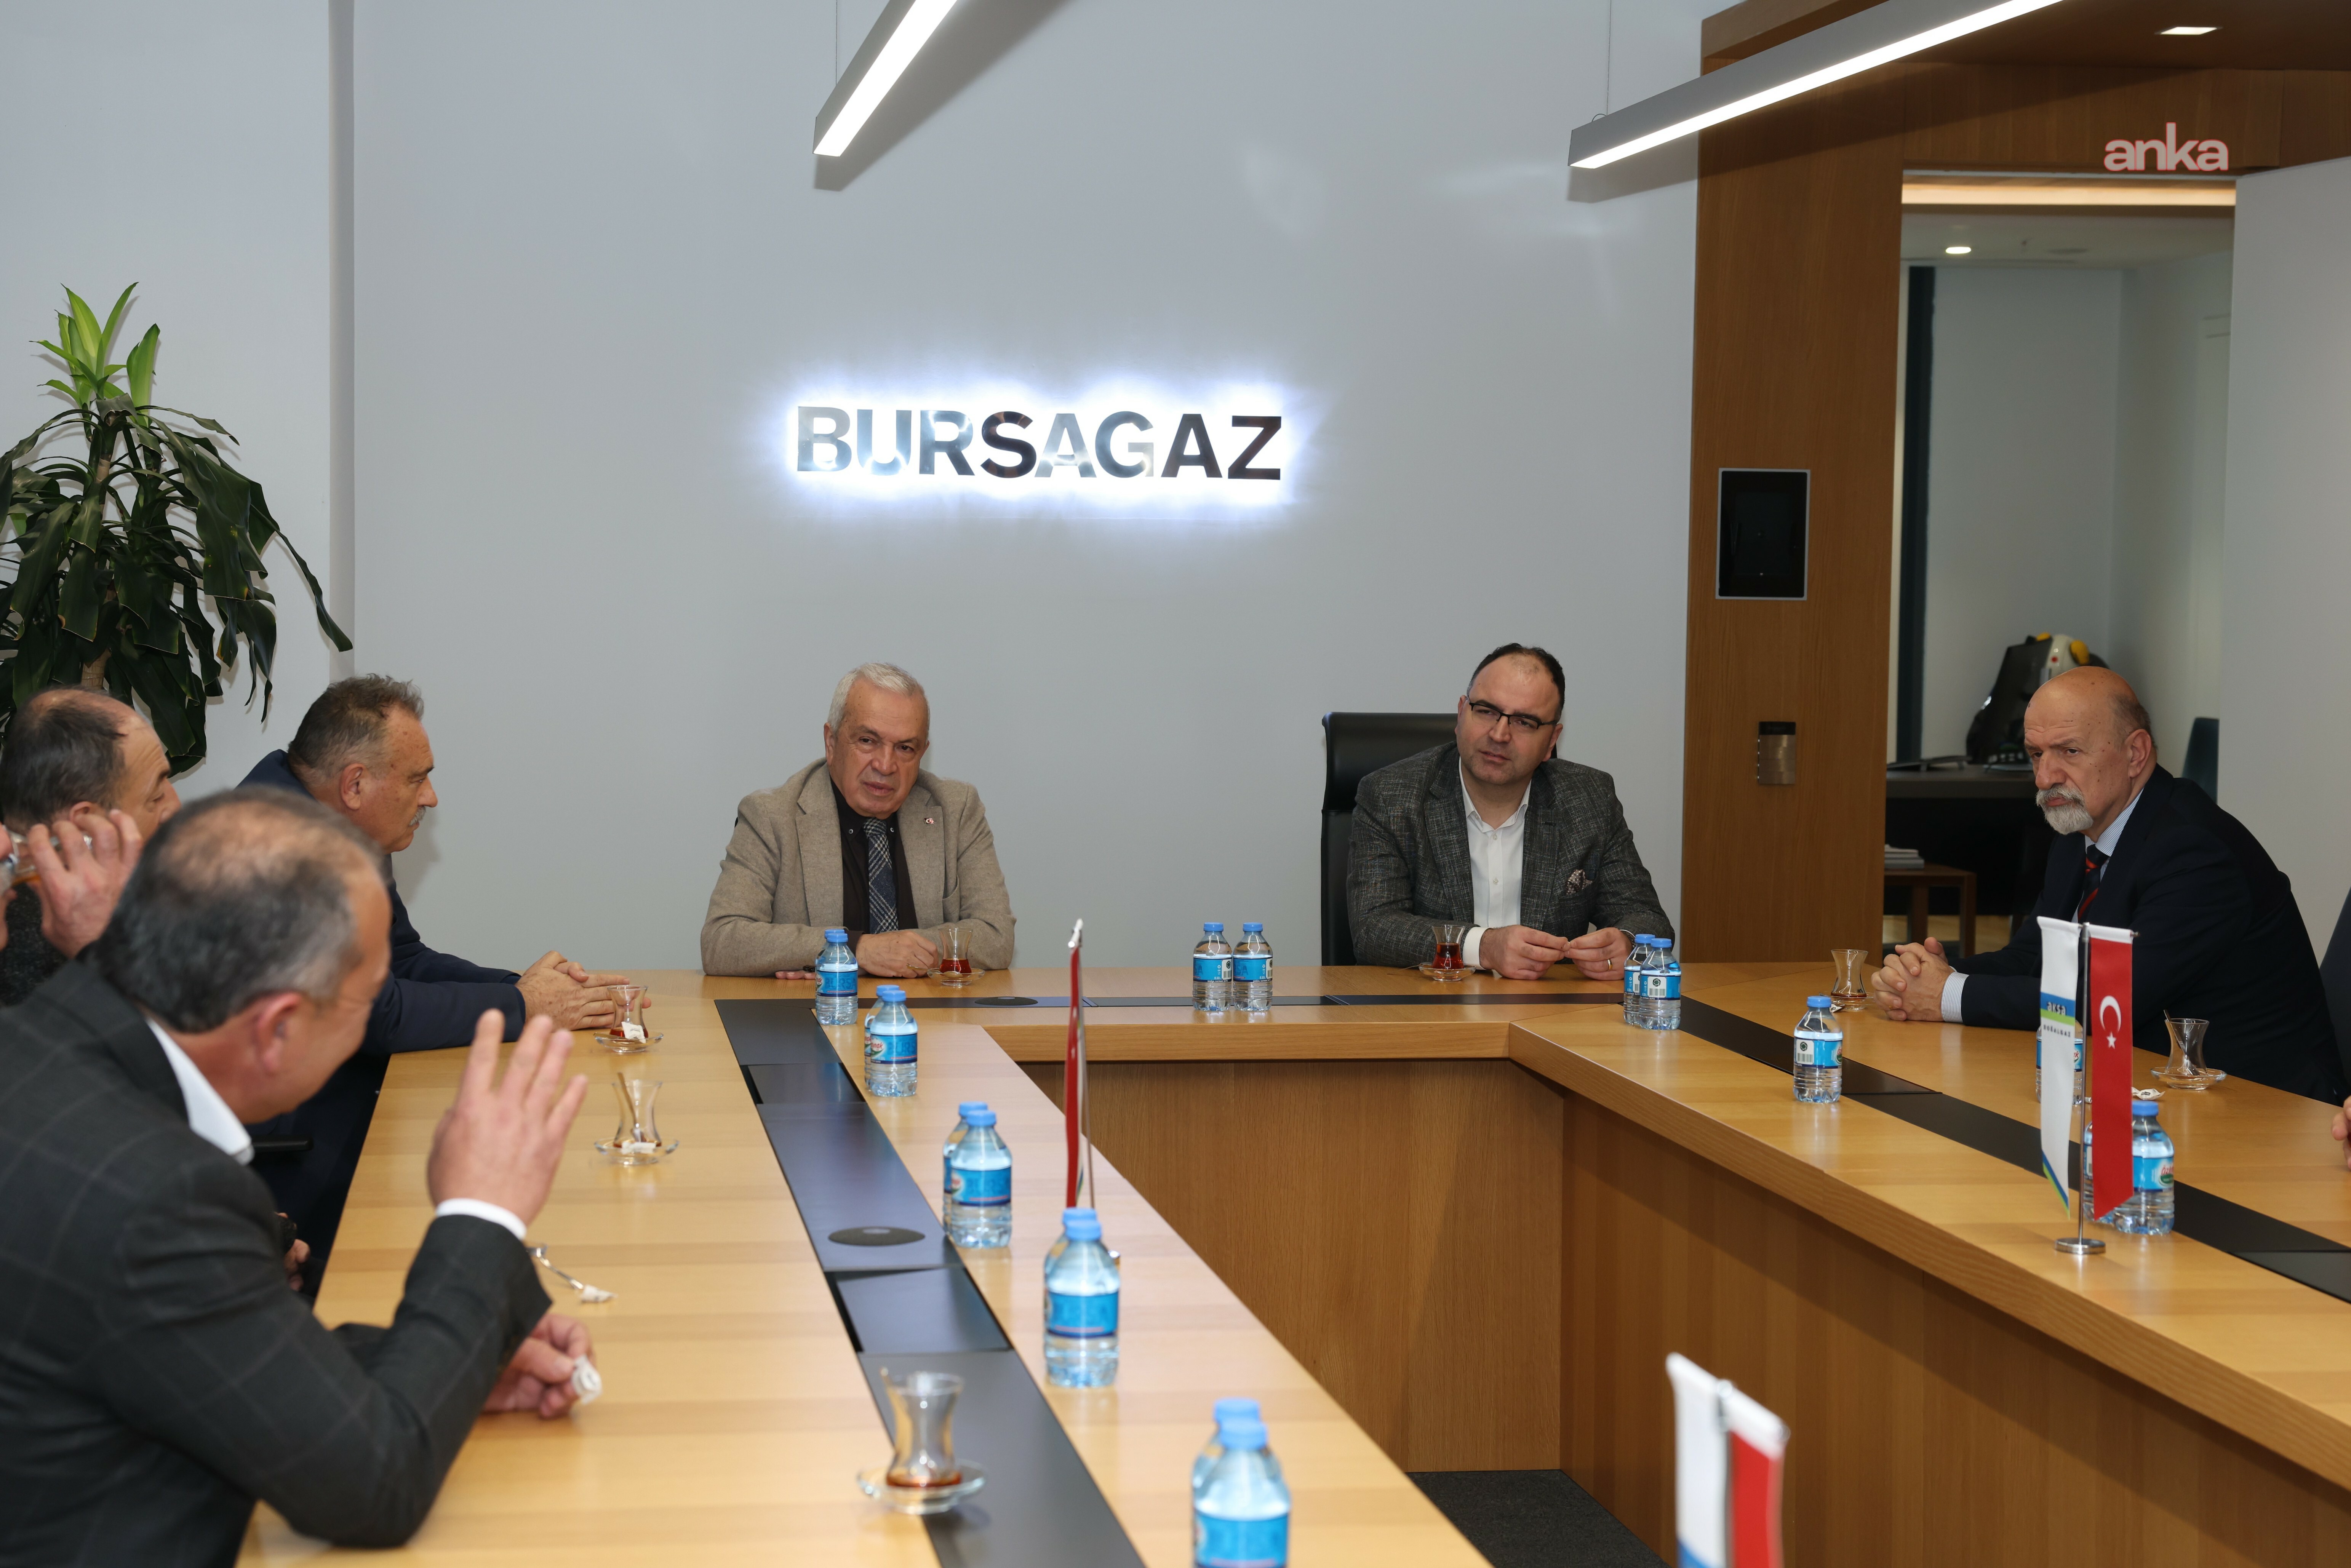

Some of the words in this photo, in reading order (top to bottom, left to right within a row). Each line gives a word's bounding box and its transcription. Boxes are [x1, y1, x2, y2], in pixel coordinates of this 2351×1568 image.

[797, 406, 1282, 480] BURSAGAZ
[2047, 1001, 2066, 1016] aksa
[2044, 1025, 2071, 1037] DOĞALGAZ
